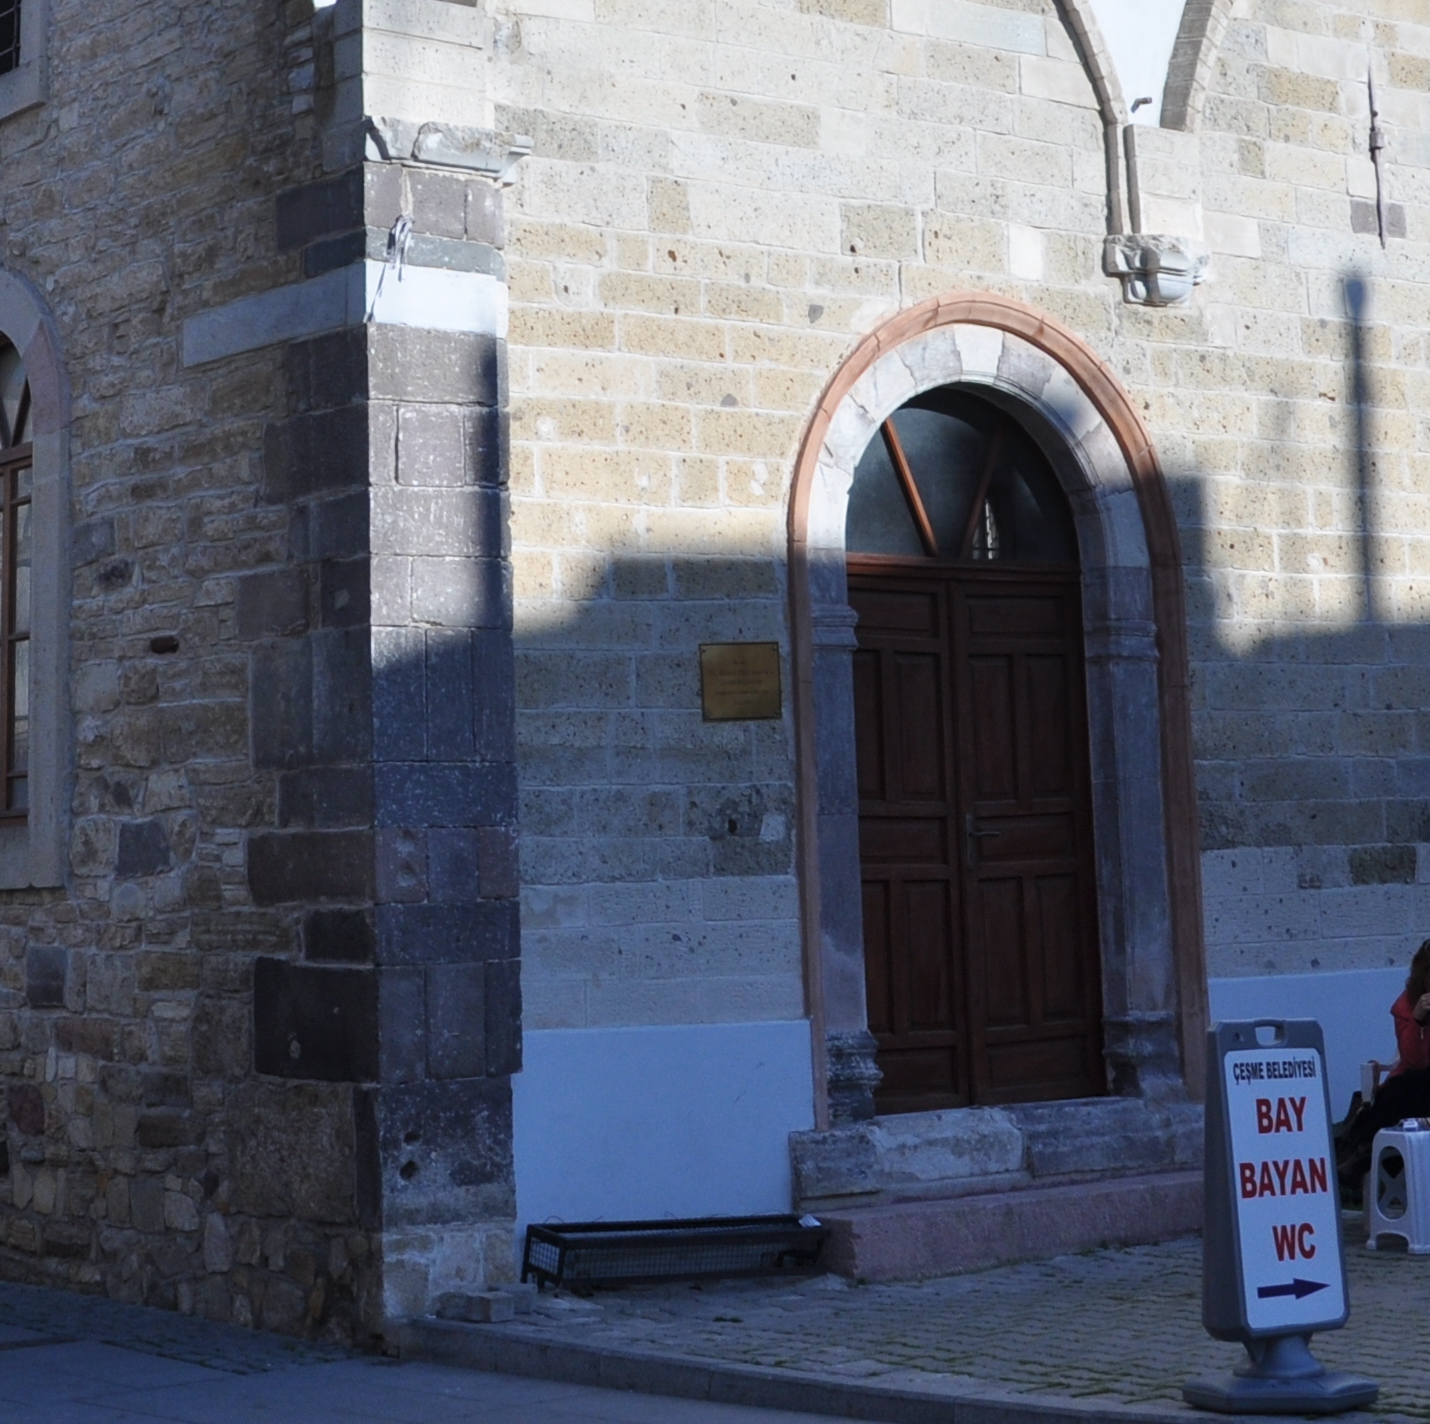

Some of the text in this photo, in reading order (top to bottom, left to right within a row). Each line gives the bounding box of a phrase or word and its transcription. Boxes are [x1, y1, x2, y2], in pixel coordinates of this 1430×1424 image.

[1233, 1056, 1317, 1086] ÇEŞME BELEDİYESİ
[1255, 1096, 1307, 1134] BAY
[1239, 1157, 1328, 1199] BAYAN
[1272, 1222, 1316, 1262] WC
